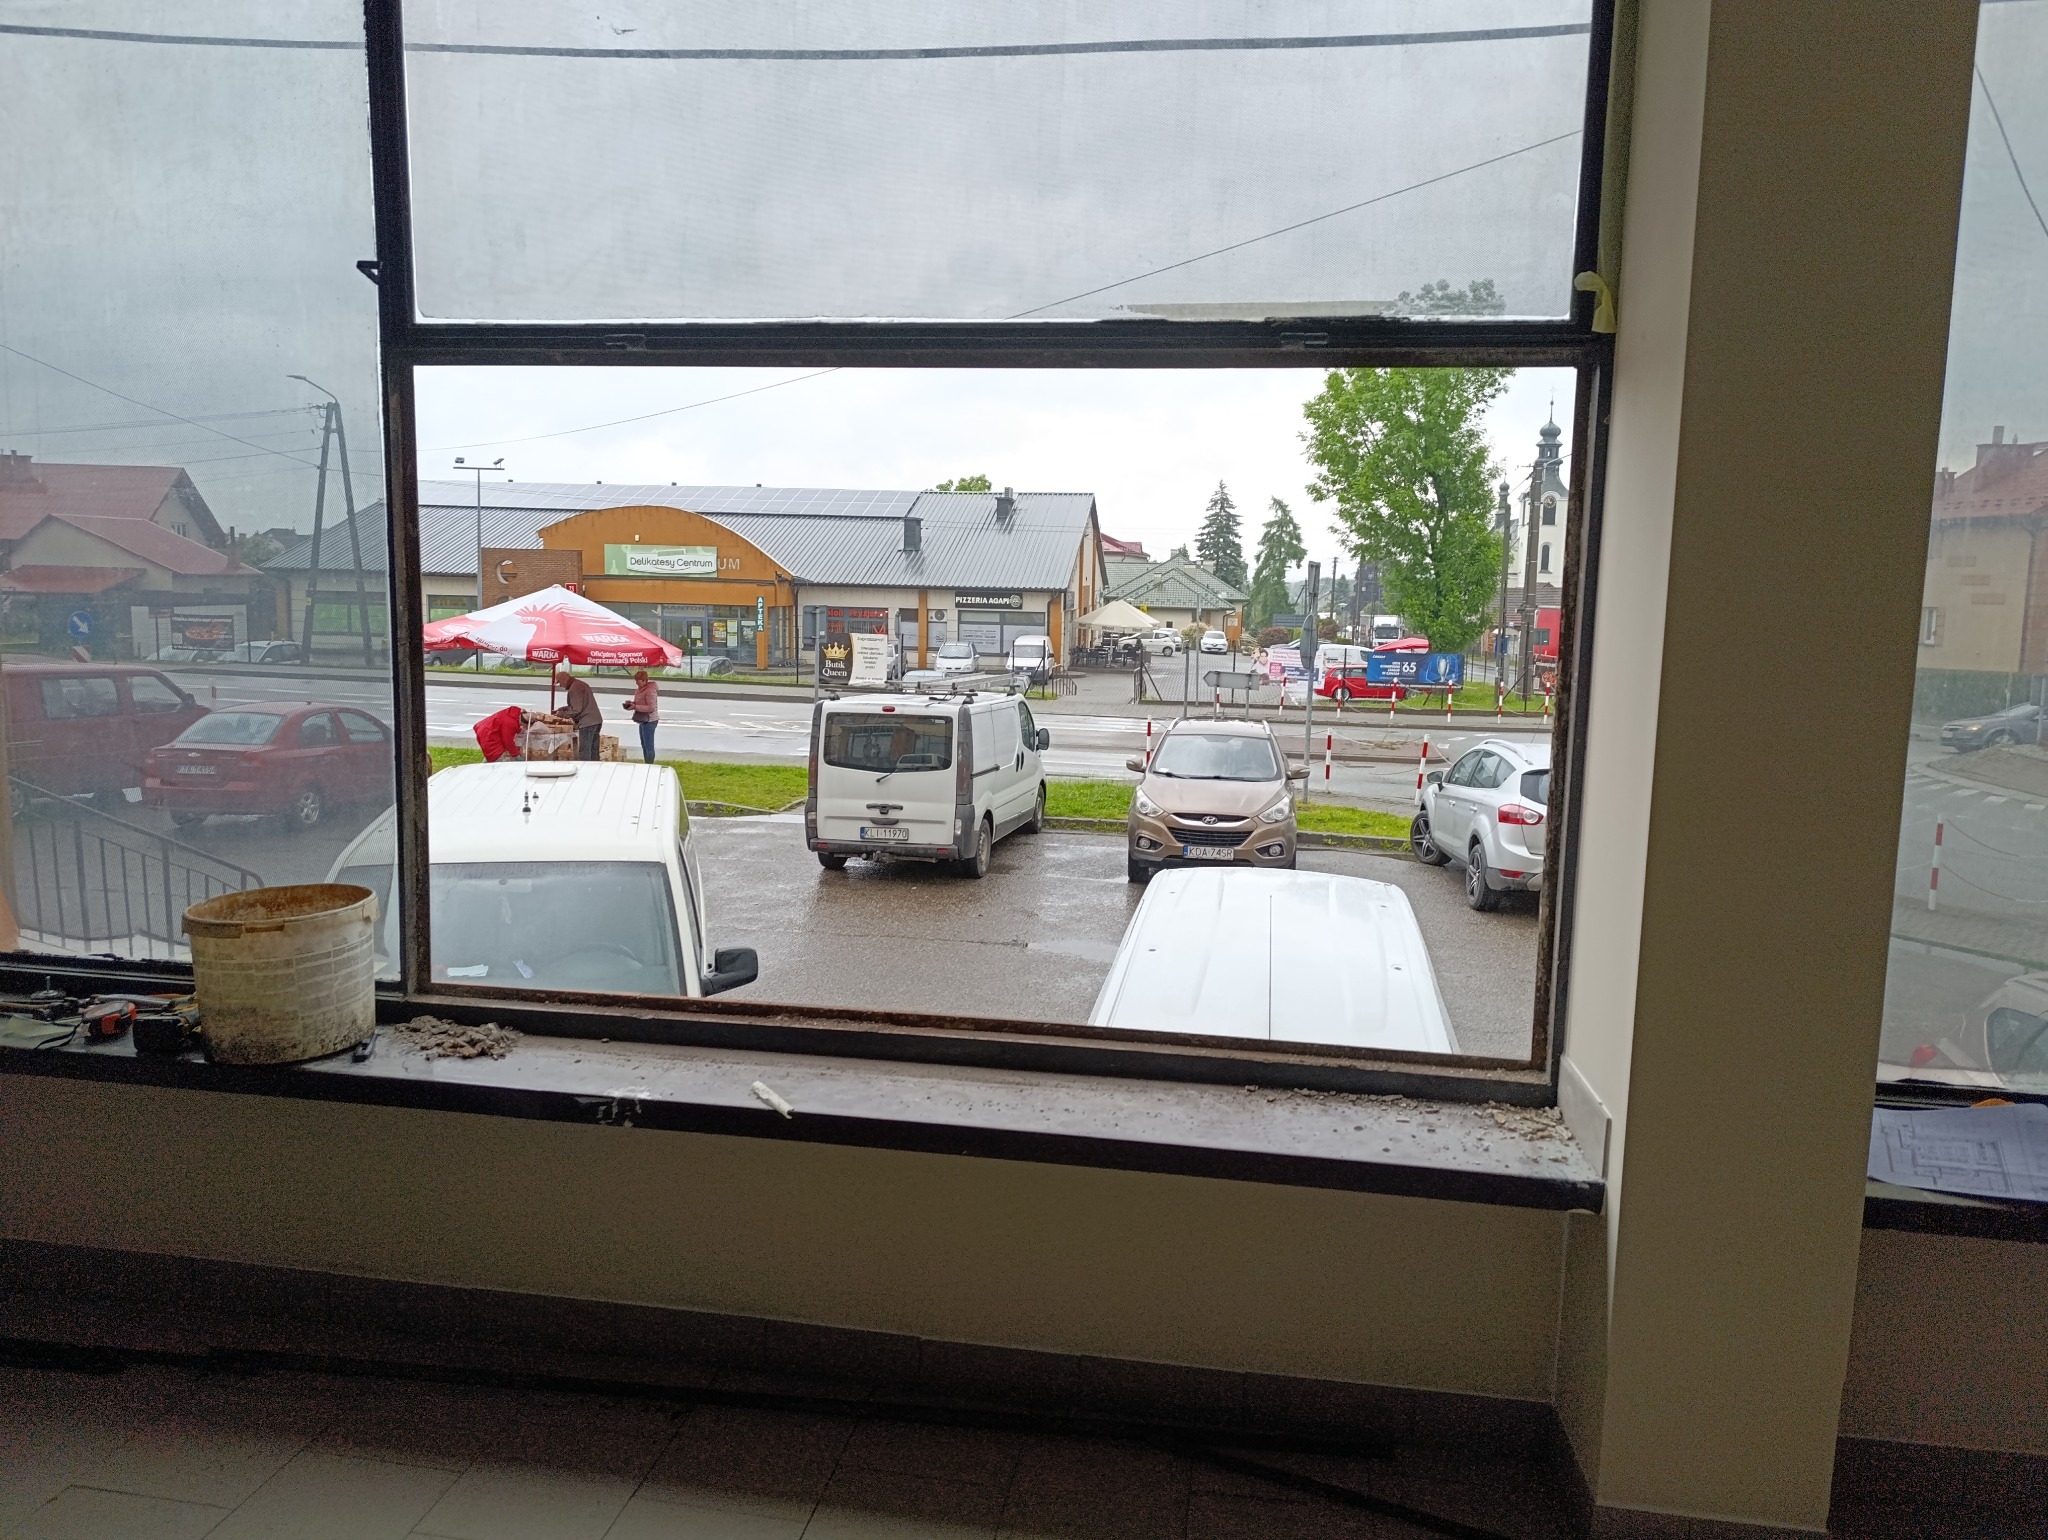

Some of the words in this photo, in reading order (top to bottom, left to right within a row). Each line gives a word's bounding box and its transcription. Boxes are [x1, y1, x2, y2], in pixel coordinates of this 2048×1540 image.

[630, 557, 675, 568] Delikatesy
[676, 558, 713, 568] Centrum
[955, 596, 988, 604] PIZZERIA
[988, 597, 1010, 605] AGAPI
[582, 635, 630, 643] WARKA
[532, 650, 559, 659] WARKA
[825, 659, 845, 669] Butik
[1402, 661, 1417, 673] 65
[822, 667, 848, 677] Queen
[865, 828, 879, 838] KLI
[884, 829, 907, 839] 11970
[1189, 847, 1208, 857] KDA
[1210, 848, 1233, 858] 74SR
